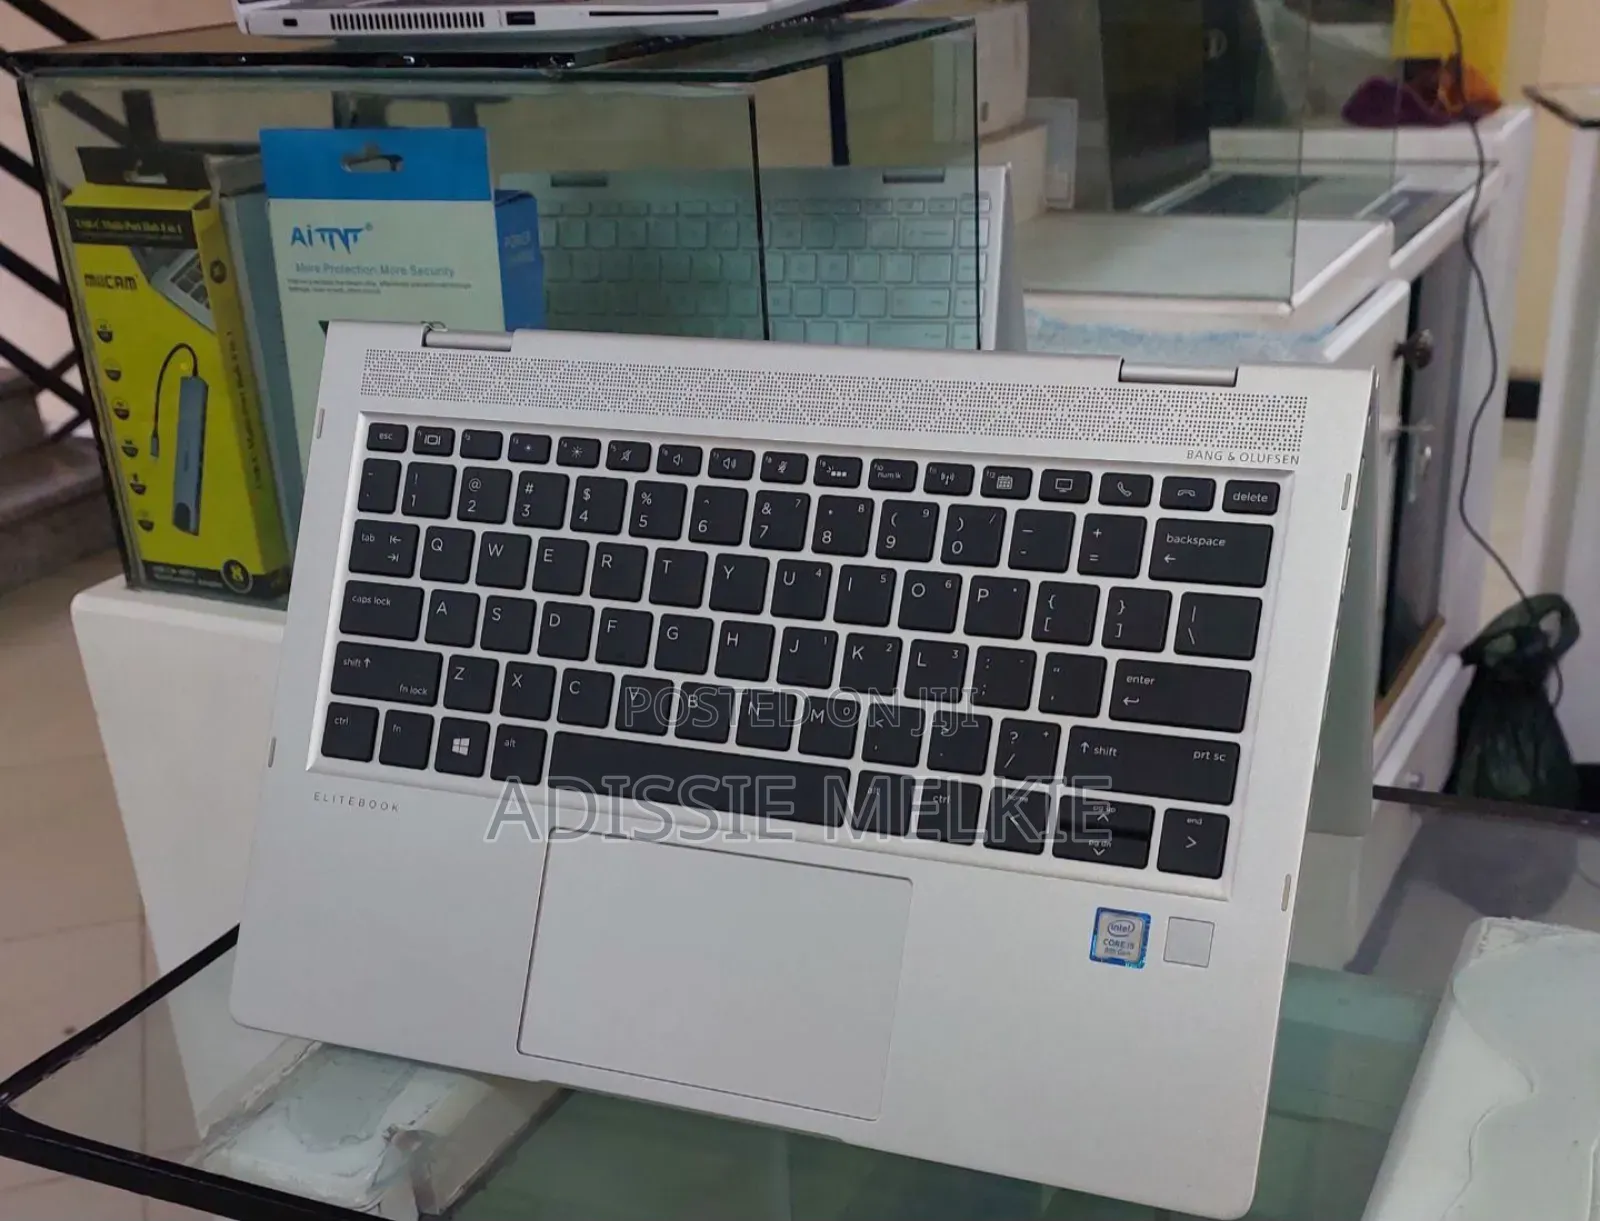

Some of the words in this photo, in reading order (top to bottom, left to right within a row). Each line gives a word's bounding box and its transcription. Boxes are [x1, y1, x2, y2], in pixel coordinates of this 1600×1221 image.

[296, 263, 319, 273] More
[323, 264, 375, 276] Protection
[380, 266, 408, 276] More
[410, 266, 455, 278] Security
[379, 432, 393, 440] esc
[1187, 450, 1222, 461] BANG
[1228, 452, 1235, 461] &
[1240, 452, 1299, 465] OLUFSEN
[468, 477, 482, 492] @
[524, 482, 534, 494] #
[411, 494, 417, 507] 1
[582, 487, 591, 501] $
[641, 491, 652, 506] %
[1232, 492, 1268, 503] delete
[467, 499, 477, 513] 2
[521, 503, 531, 517] 3
[761, 502, 772, 515] &
[795, 498, 802, 508] 7
[857, 503, 865, 513] 8
[579, 509, 589, 522] 4
[922, 508, 930, 518] 9
[638, 514, 648, 528] 5
[698, 519, 708, 533] 6
[361, 533, 376, 543] tab
[759, 524, 769, 539] 7
[821, 530, 832, 544] 8
[1092, 528, 1102, 538] +
[431, 537, 443, 552] Q
[885, 535, 896, 549] 9
[1167, 533, 1225, 546] backspace
[489, 543, 503, 556] W
[543, 548, 554, 563] E
[601, 554, 613, 569] R
[1089, 554, 1099, 562] =
[662, 559, 673, 574] T
[723, 565, 735, 580] Y
[815, 568, 822, 578] 4
[783, 570, 796, 586] U
[880, 573, 887, 584] 5
[944, 579, 952, 589] 6
[911, 582, 926, 598] O
[977, 588, 990, 603] P
[374, 597, 390, 605] lock
[436, 601, 448, 615] A
[491, 607, 502, 622] S
[549, 613, 561, 627] D
[607, 619, 618, 633] F
[666, 626, 679, 641] G
[726, 631, 739, 647] H
[789, 639, 800, 653] J
[851, 645, 865, 661] K
[885, 643, 893, 652] 2
[917, 651, 927, 667] L
[952, 650, 959, 658] 3
[344, 658, 360, 667] shift
[453, 666, 465, 681] Z
[511, 673, 523, 688] X
[1127, 676, 1154, 684] enter
[400, 684, 409, 693] fn
[410, 685, 427, 695] lock
[569, 680, 581, 695] C
[688, 695, 698, 708] B
[748, 702, 760, 716] N
[334, 716, 349, 725] ctrl
[810, 709, 825, 724] M
[392, 723, 402, 733] fn
[504, 738, 516, 748] alt
[1010, 731, 1018, 744] ?
[1094, 747, 1117, 756] shift
[1194, 751, 1210, 759] prt
[1213, 753, 1226, 762] sc
[314, 792, 399, 812] ELITEBOOK
[933, 795, 950, 804] ctrl
[1186, 817, 1203, 826] end
[1110, 923, 1131, 933] intel
[1103, 938, 1125, 948] CORE
